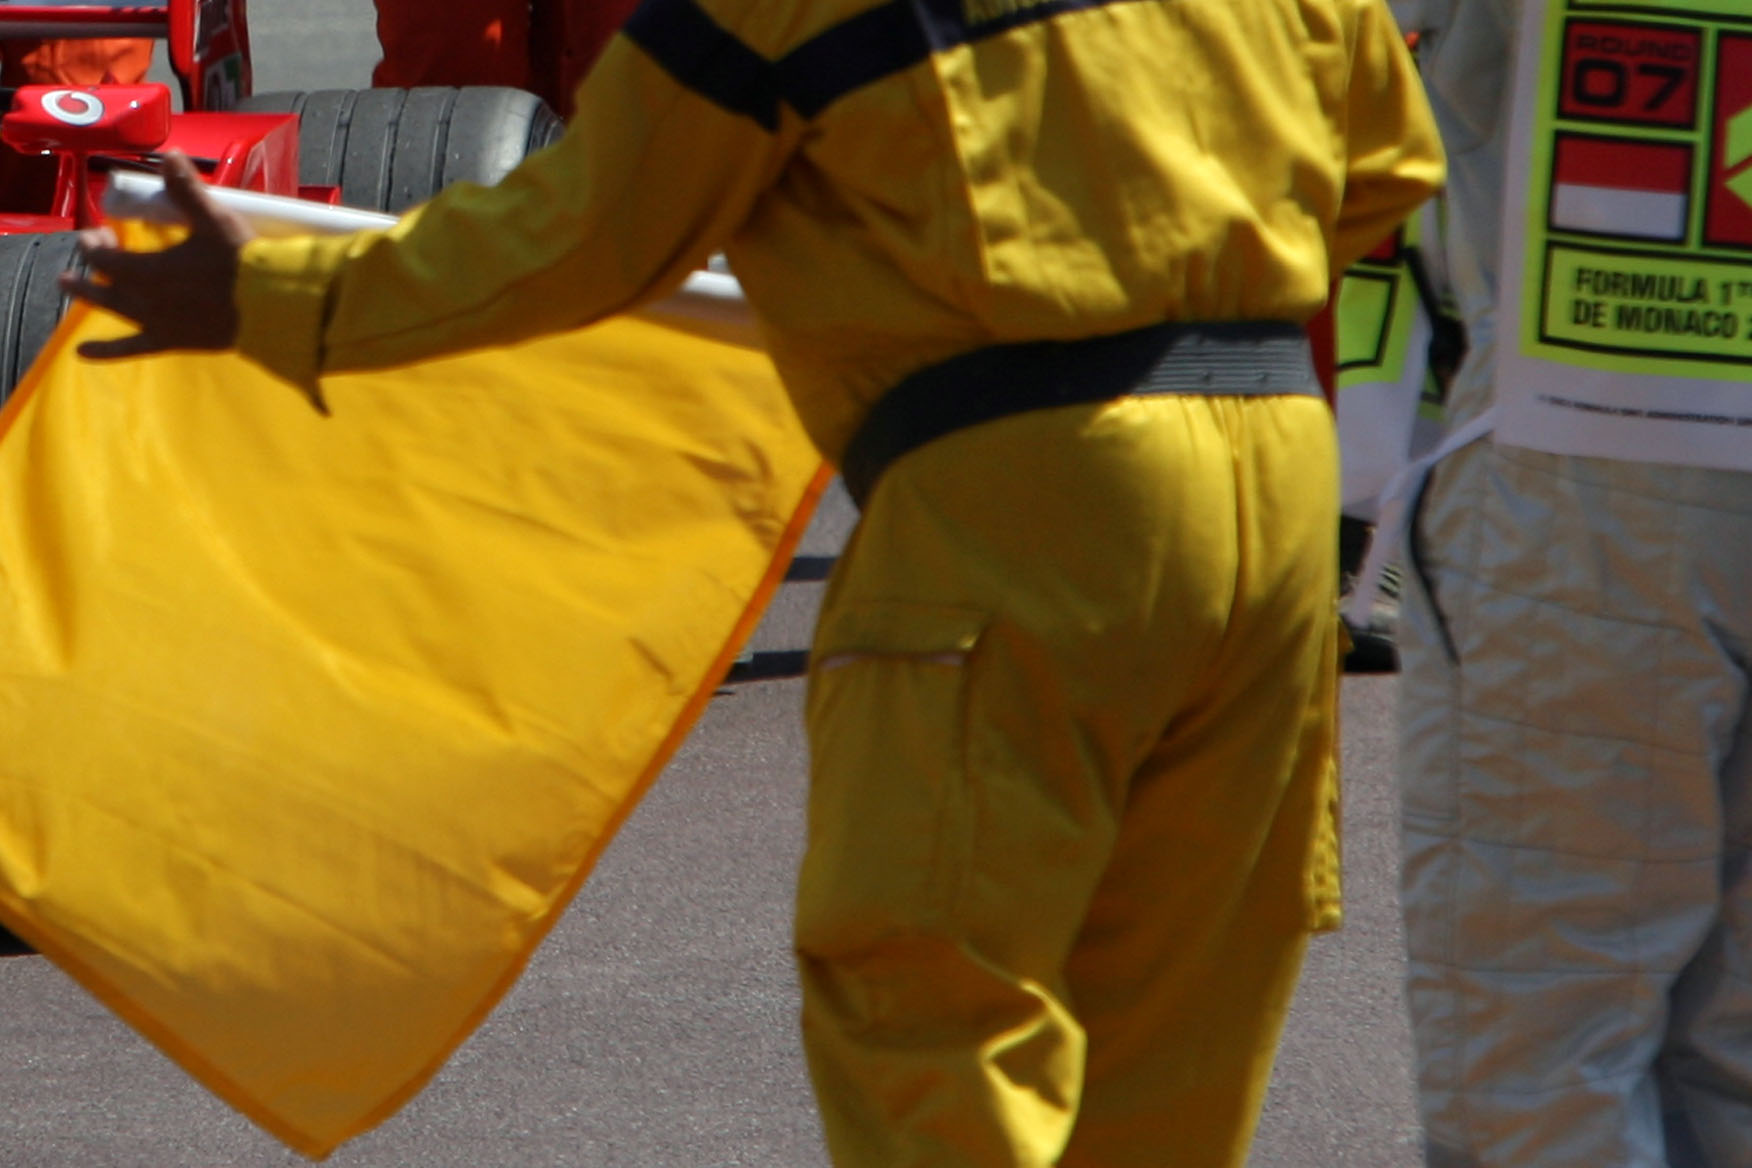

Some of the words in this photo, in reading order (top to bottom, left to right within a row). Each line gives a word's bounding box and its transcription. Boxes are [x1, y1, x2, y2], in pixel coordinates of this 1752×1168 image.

[1576, 34, 1693, 61] ROUND
[1572, 57, 1686, 111] 07
[1575, 267, 1710, 304] FORMULA
[1572, 298, 1606, 328] DE
[1616, 304, 1739, 339] MONACO
